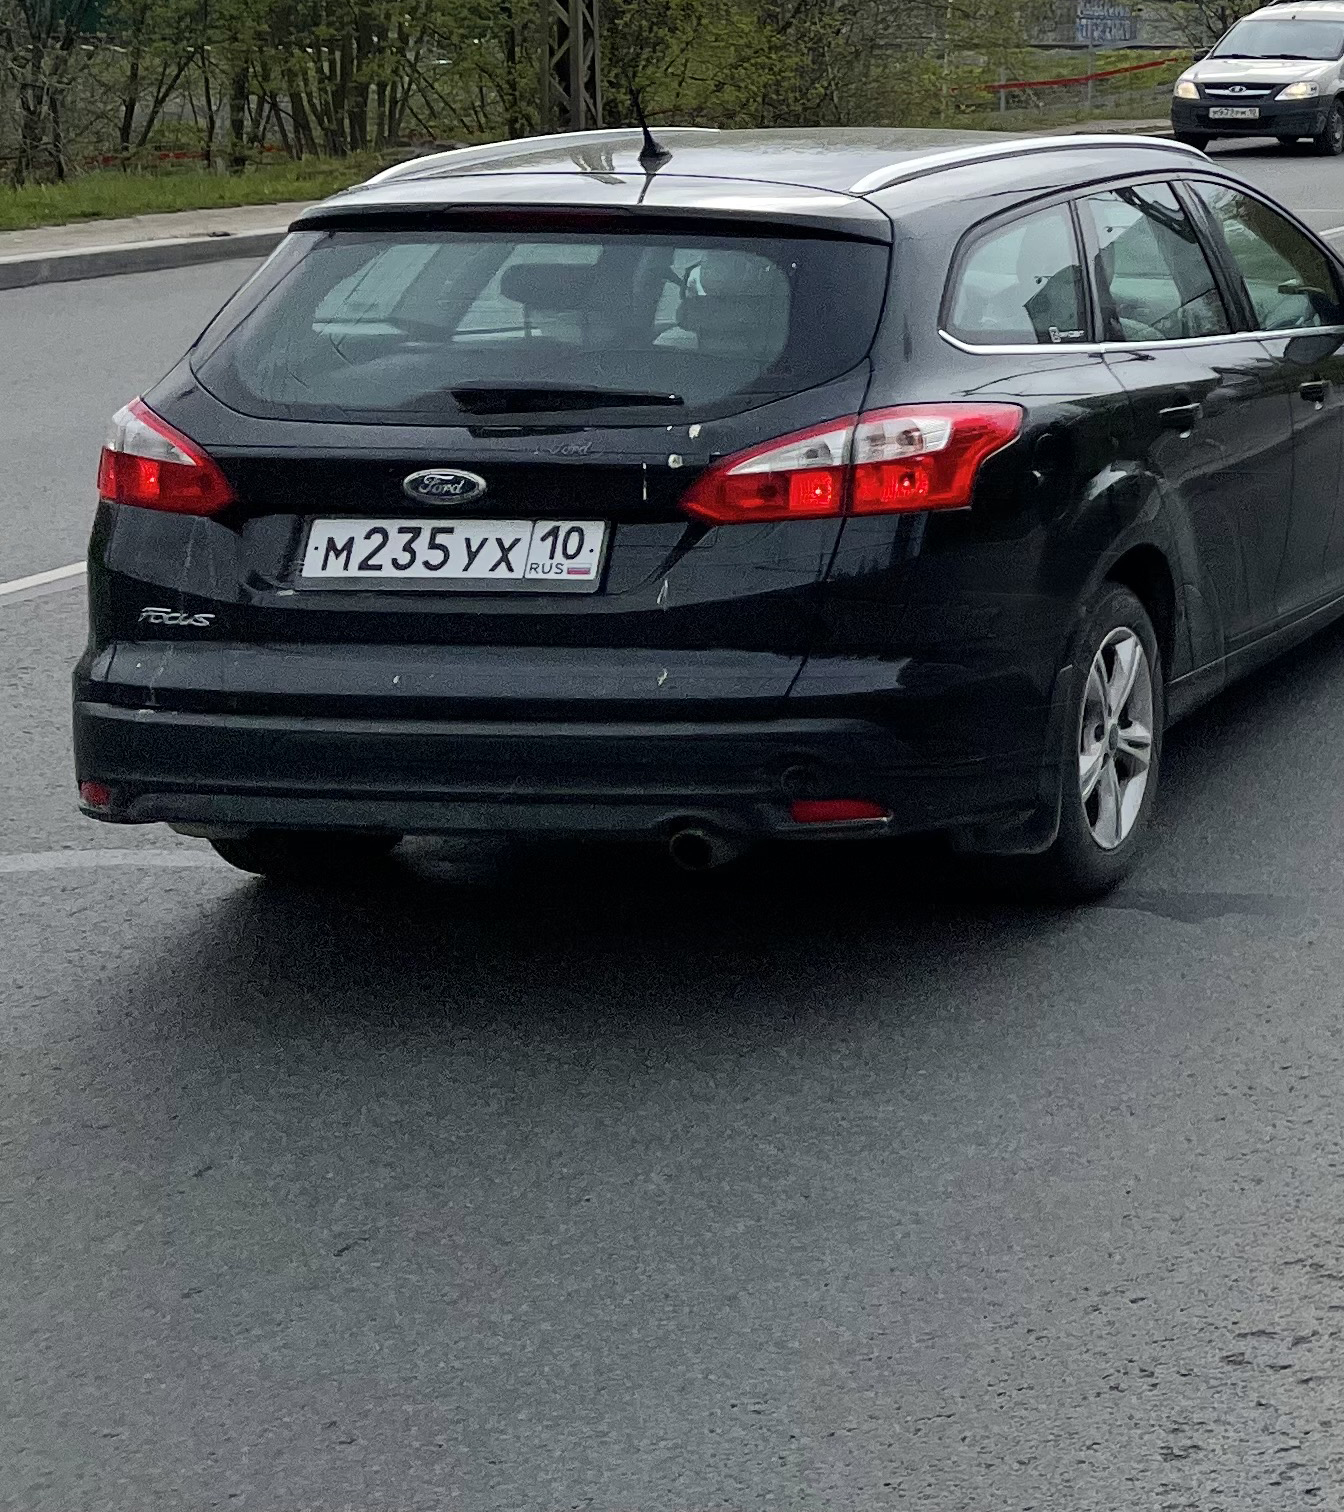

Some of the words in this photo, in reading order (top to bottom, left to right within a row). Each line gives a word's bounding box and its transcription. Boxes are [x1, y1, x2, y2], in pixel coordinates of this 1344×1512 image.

[419, 474, 465, 494] Ford
[321, 526, 522, 572] М235УХ
[540, 524, 585, 561] 10
[529, 562, 564, 574] RUS
